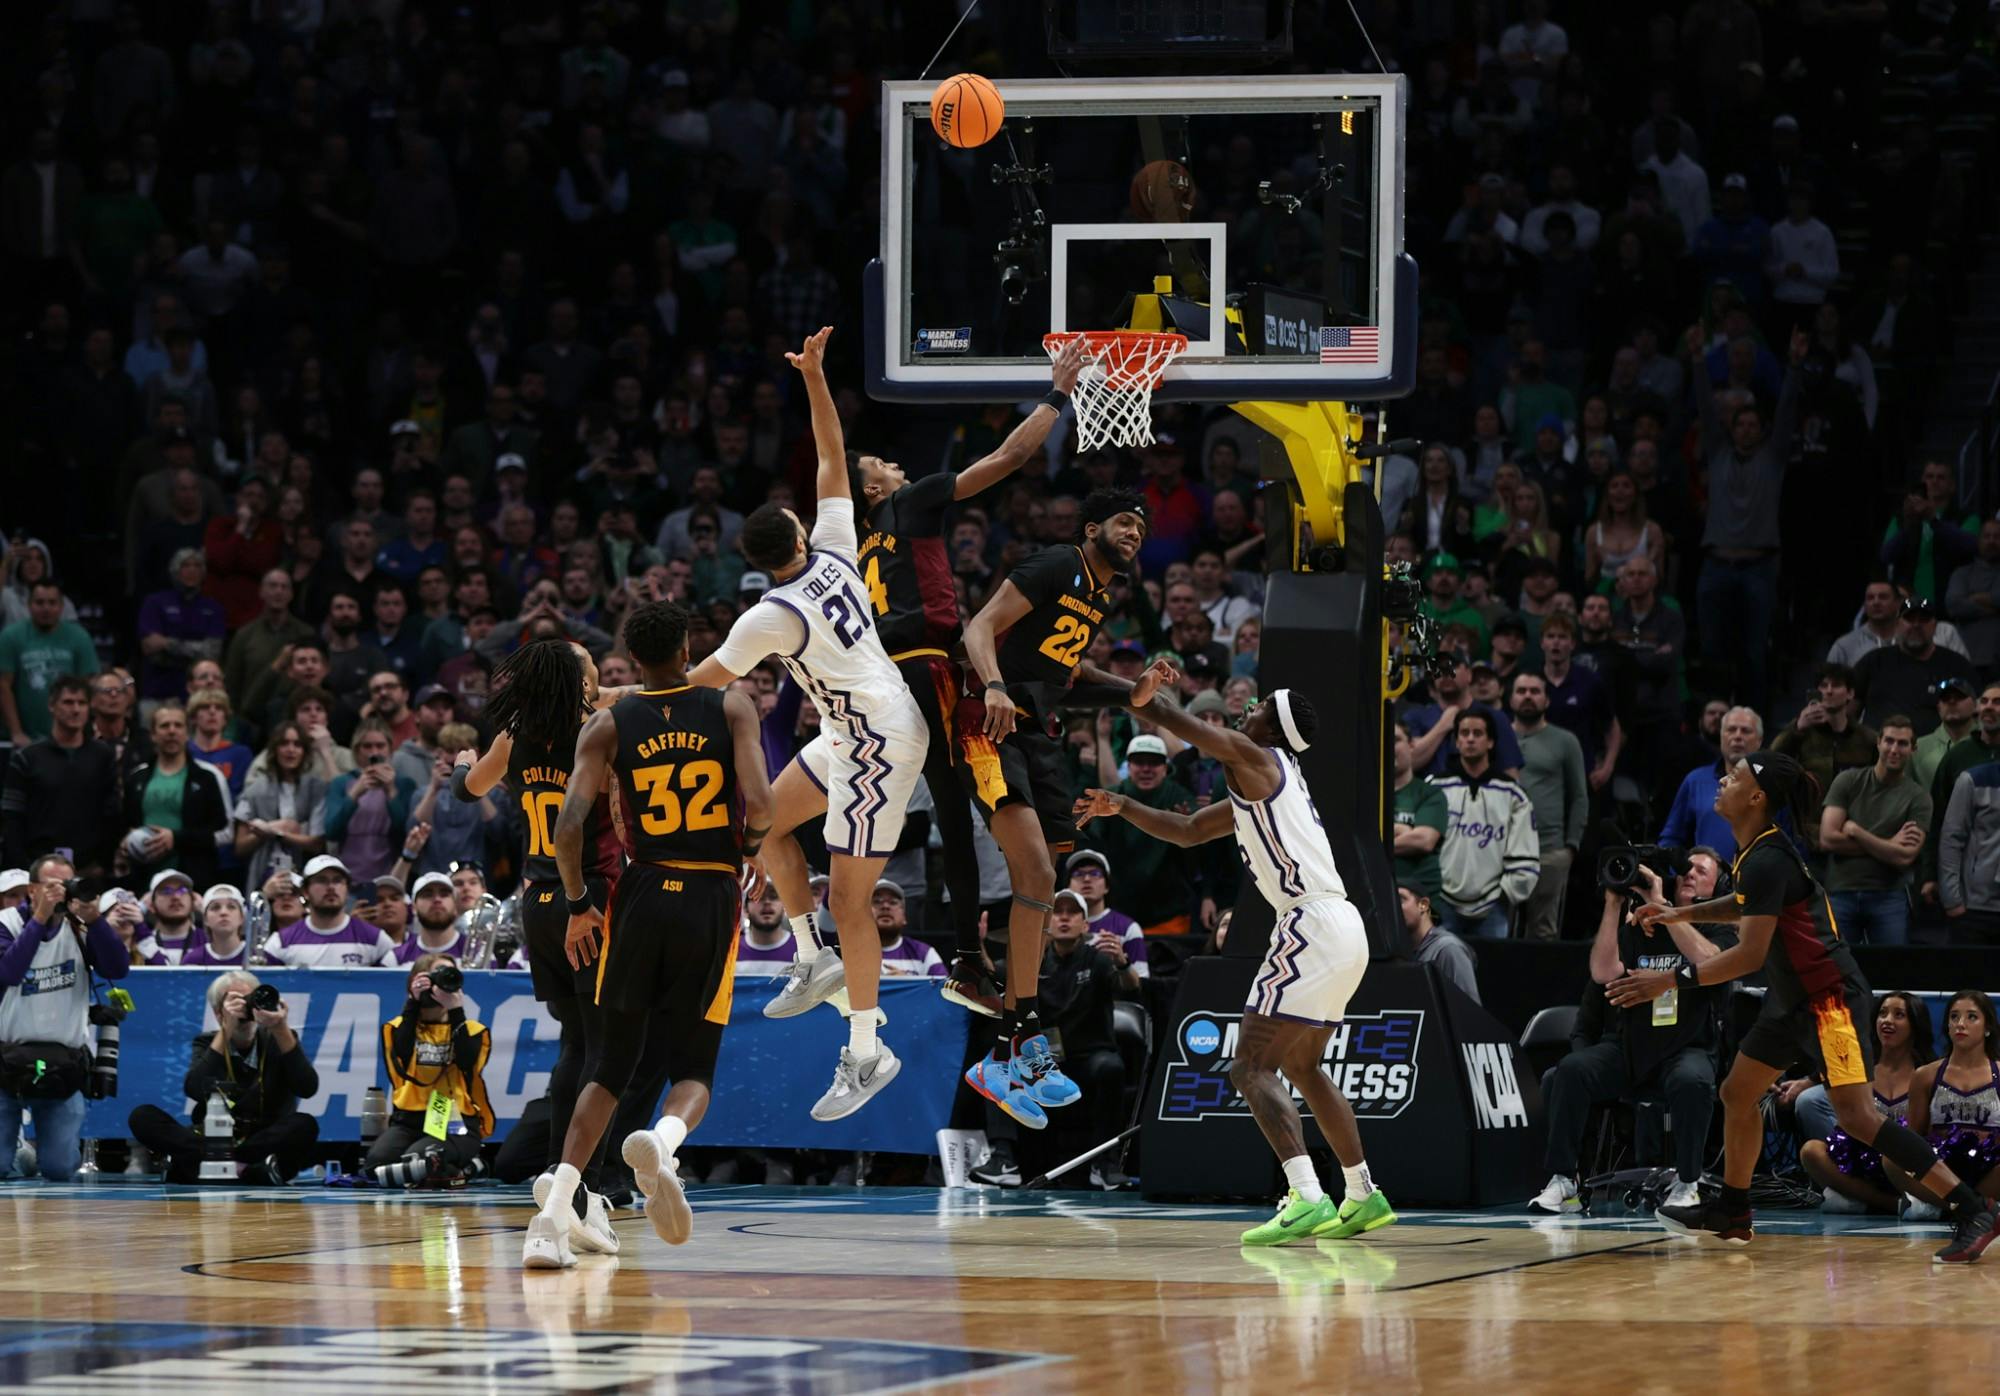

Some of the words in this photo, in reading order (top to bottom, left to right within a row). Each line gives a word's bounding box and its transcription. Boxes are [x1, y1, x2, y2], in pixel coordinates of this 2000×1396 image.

[927, 330, 956, 340] MARCH
[930, 339, 969, 349] MADNESS
[882, 534, 897, 554] JR.
[802, 563, 841, 601] COLES
[864, 554, 890, 616] 4
[821, 581, 871, 650] 21
[1057, 593, 1092, 617] ARIZONA
[1038, 614, 1091, 668] 22
[636, 731, 709, 760] GAFFNEY
[631, 758, 730, 836] 32
[521, 790, 566, 858] 10
[1448, 810, 1505, 849] Frogs
[661, 878, 684, 893] ASU
[1190, 1035, 1220, 1047] NCAA
[1461, 1043, 1528, 1130] NCAA
